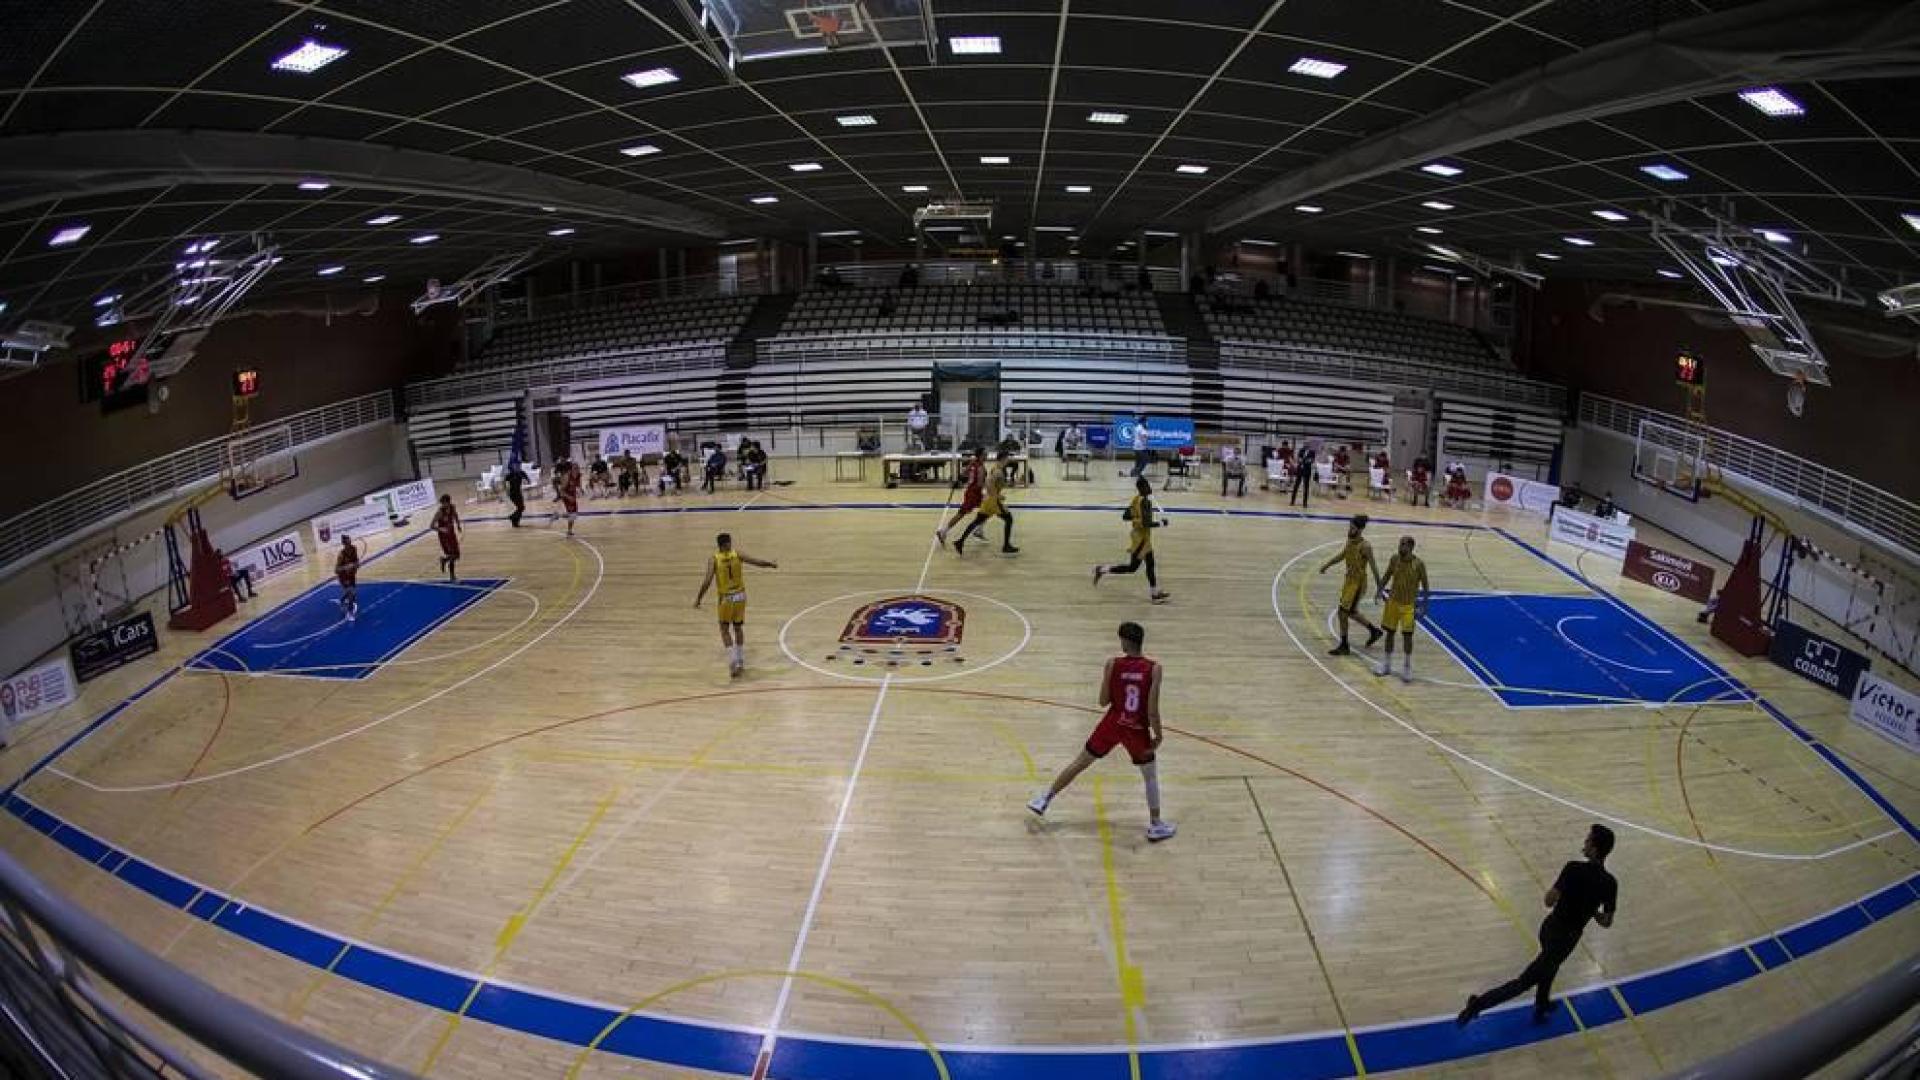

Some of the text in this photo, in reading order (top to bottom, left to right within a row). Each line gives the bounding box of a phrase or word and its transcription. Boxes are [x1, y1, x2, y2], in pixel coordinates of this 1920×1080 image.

[111, 621, 149, 647] iCars
[1124, 684, 1140, 712] 8
[1860, 680, 1915, 721] Victor
